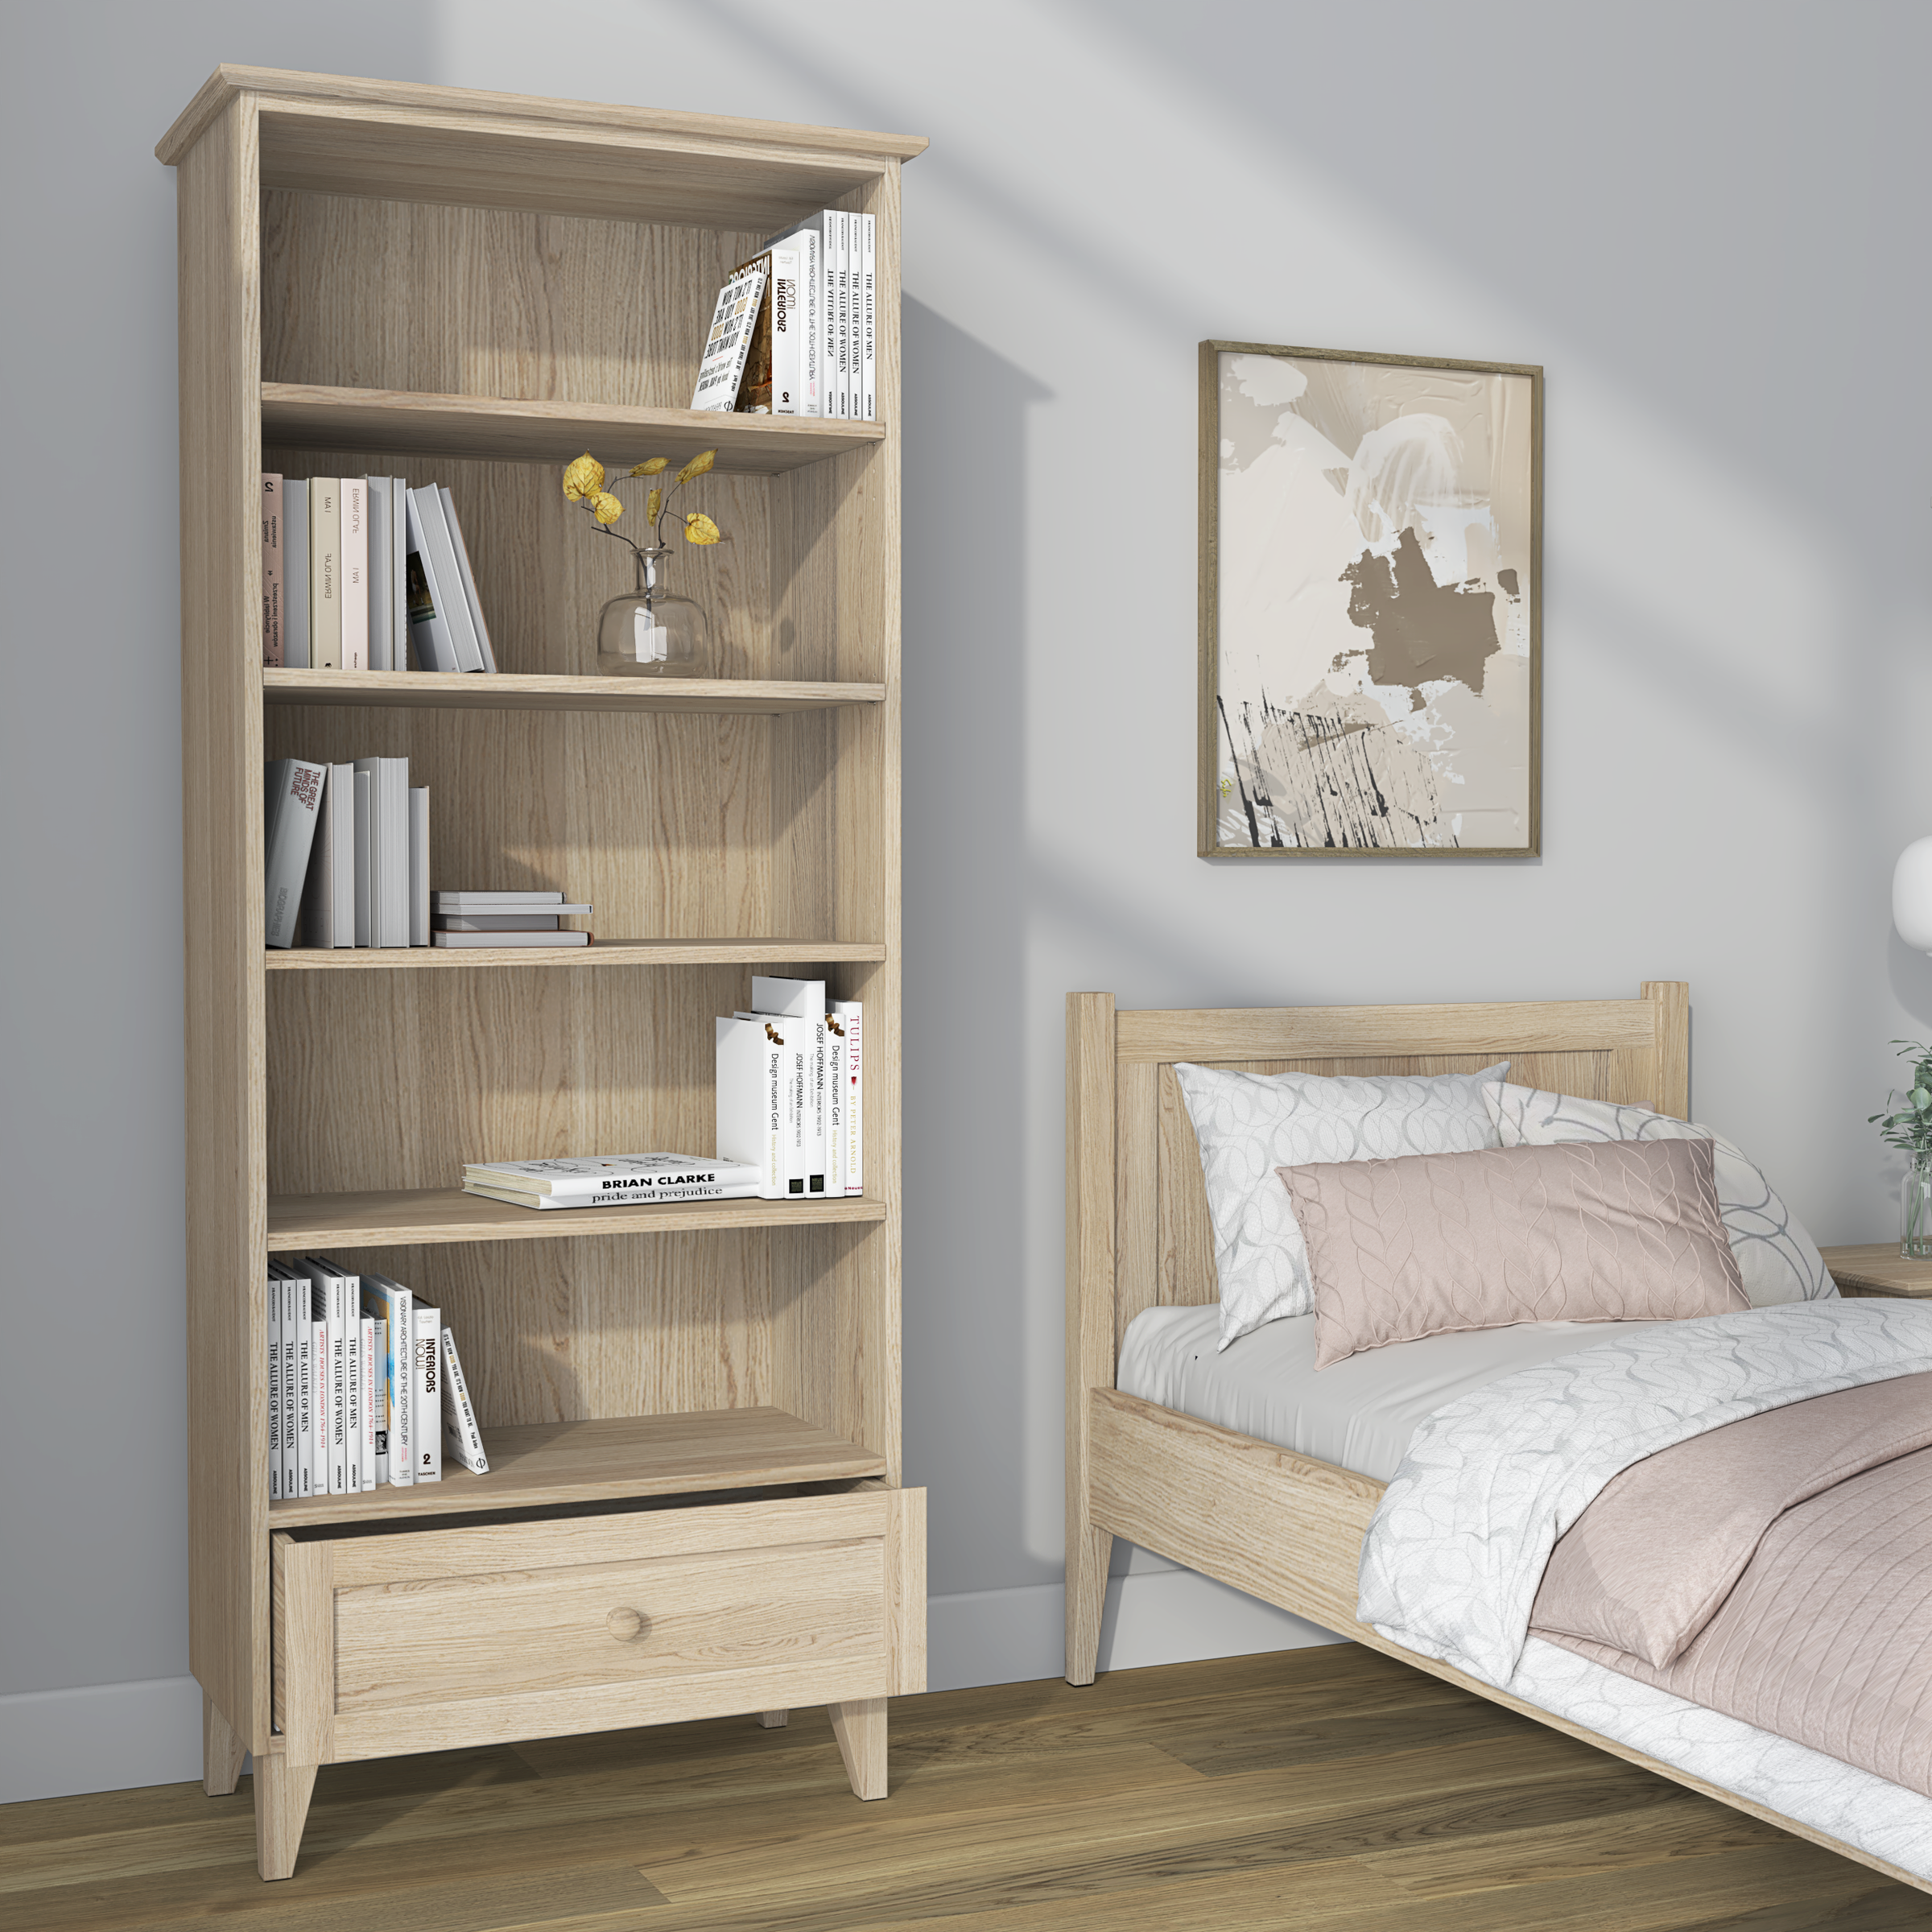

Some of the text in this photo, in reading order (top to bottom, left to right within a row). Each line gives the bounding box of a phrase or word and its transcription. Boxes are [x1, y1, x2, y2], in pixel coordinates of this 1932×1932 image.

[840, 325, 846, 337] OF
[852, 327, 859, 338] OF
[866, 328, 872, 339] OF
[291, 767, 303, 795] FUTURE
[299, 769, 312, 804] MINDS OF
[306, 772, 320, 811] THE GREAT
[850, 1016, 860, 1071] TULIPS
[769, 1054, 779, 1079] Design
[830, 1046, 840, 1071] Design
[850, 1096, 856, 1105] BY
[771, 1113, 779, 1130] Gent
[602, 1174, 715, 1189] BRIAN CLARKE
[592, 1187, 723, 1203] pride and prejudice
[286, 1341, 294, 1360] THE
[415, 1339, 425, 1369] NOW!
[426, 1339, 436, 1393] INTERIORS
[286, 1362, 294, 1397] ALLURE
[401, 1373, 407, 1381] OF
[270, 1400, 279, 1413] OF
[287, 1399, 294, 1412] OF
[301, 1397, 308, 1410] OF
[335, 1395, 342, 1408] OF
[350, 1394, 357, 1407] OF
[270, 1414, 279, 1450] WOMEN
[335, 1410, 343, 1445] WOMEN
[423, 1454, 431, 1465] 2
